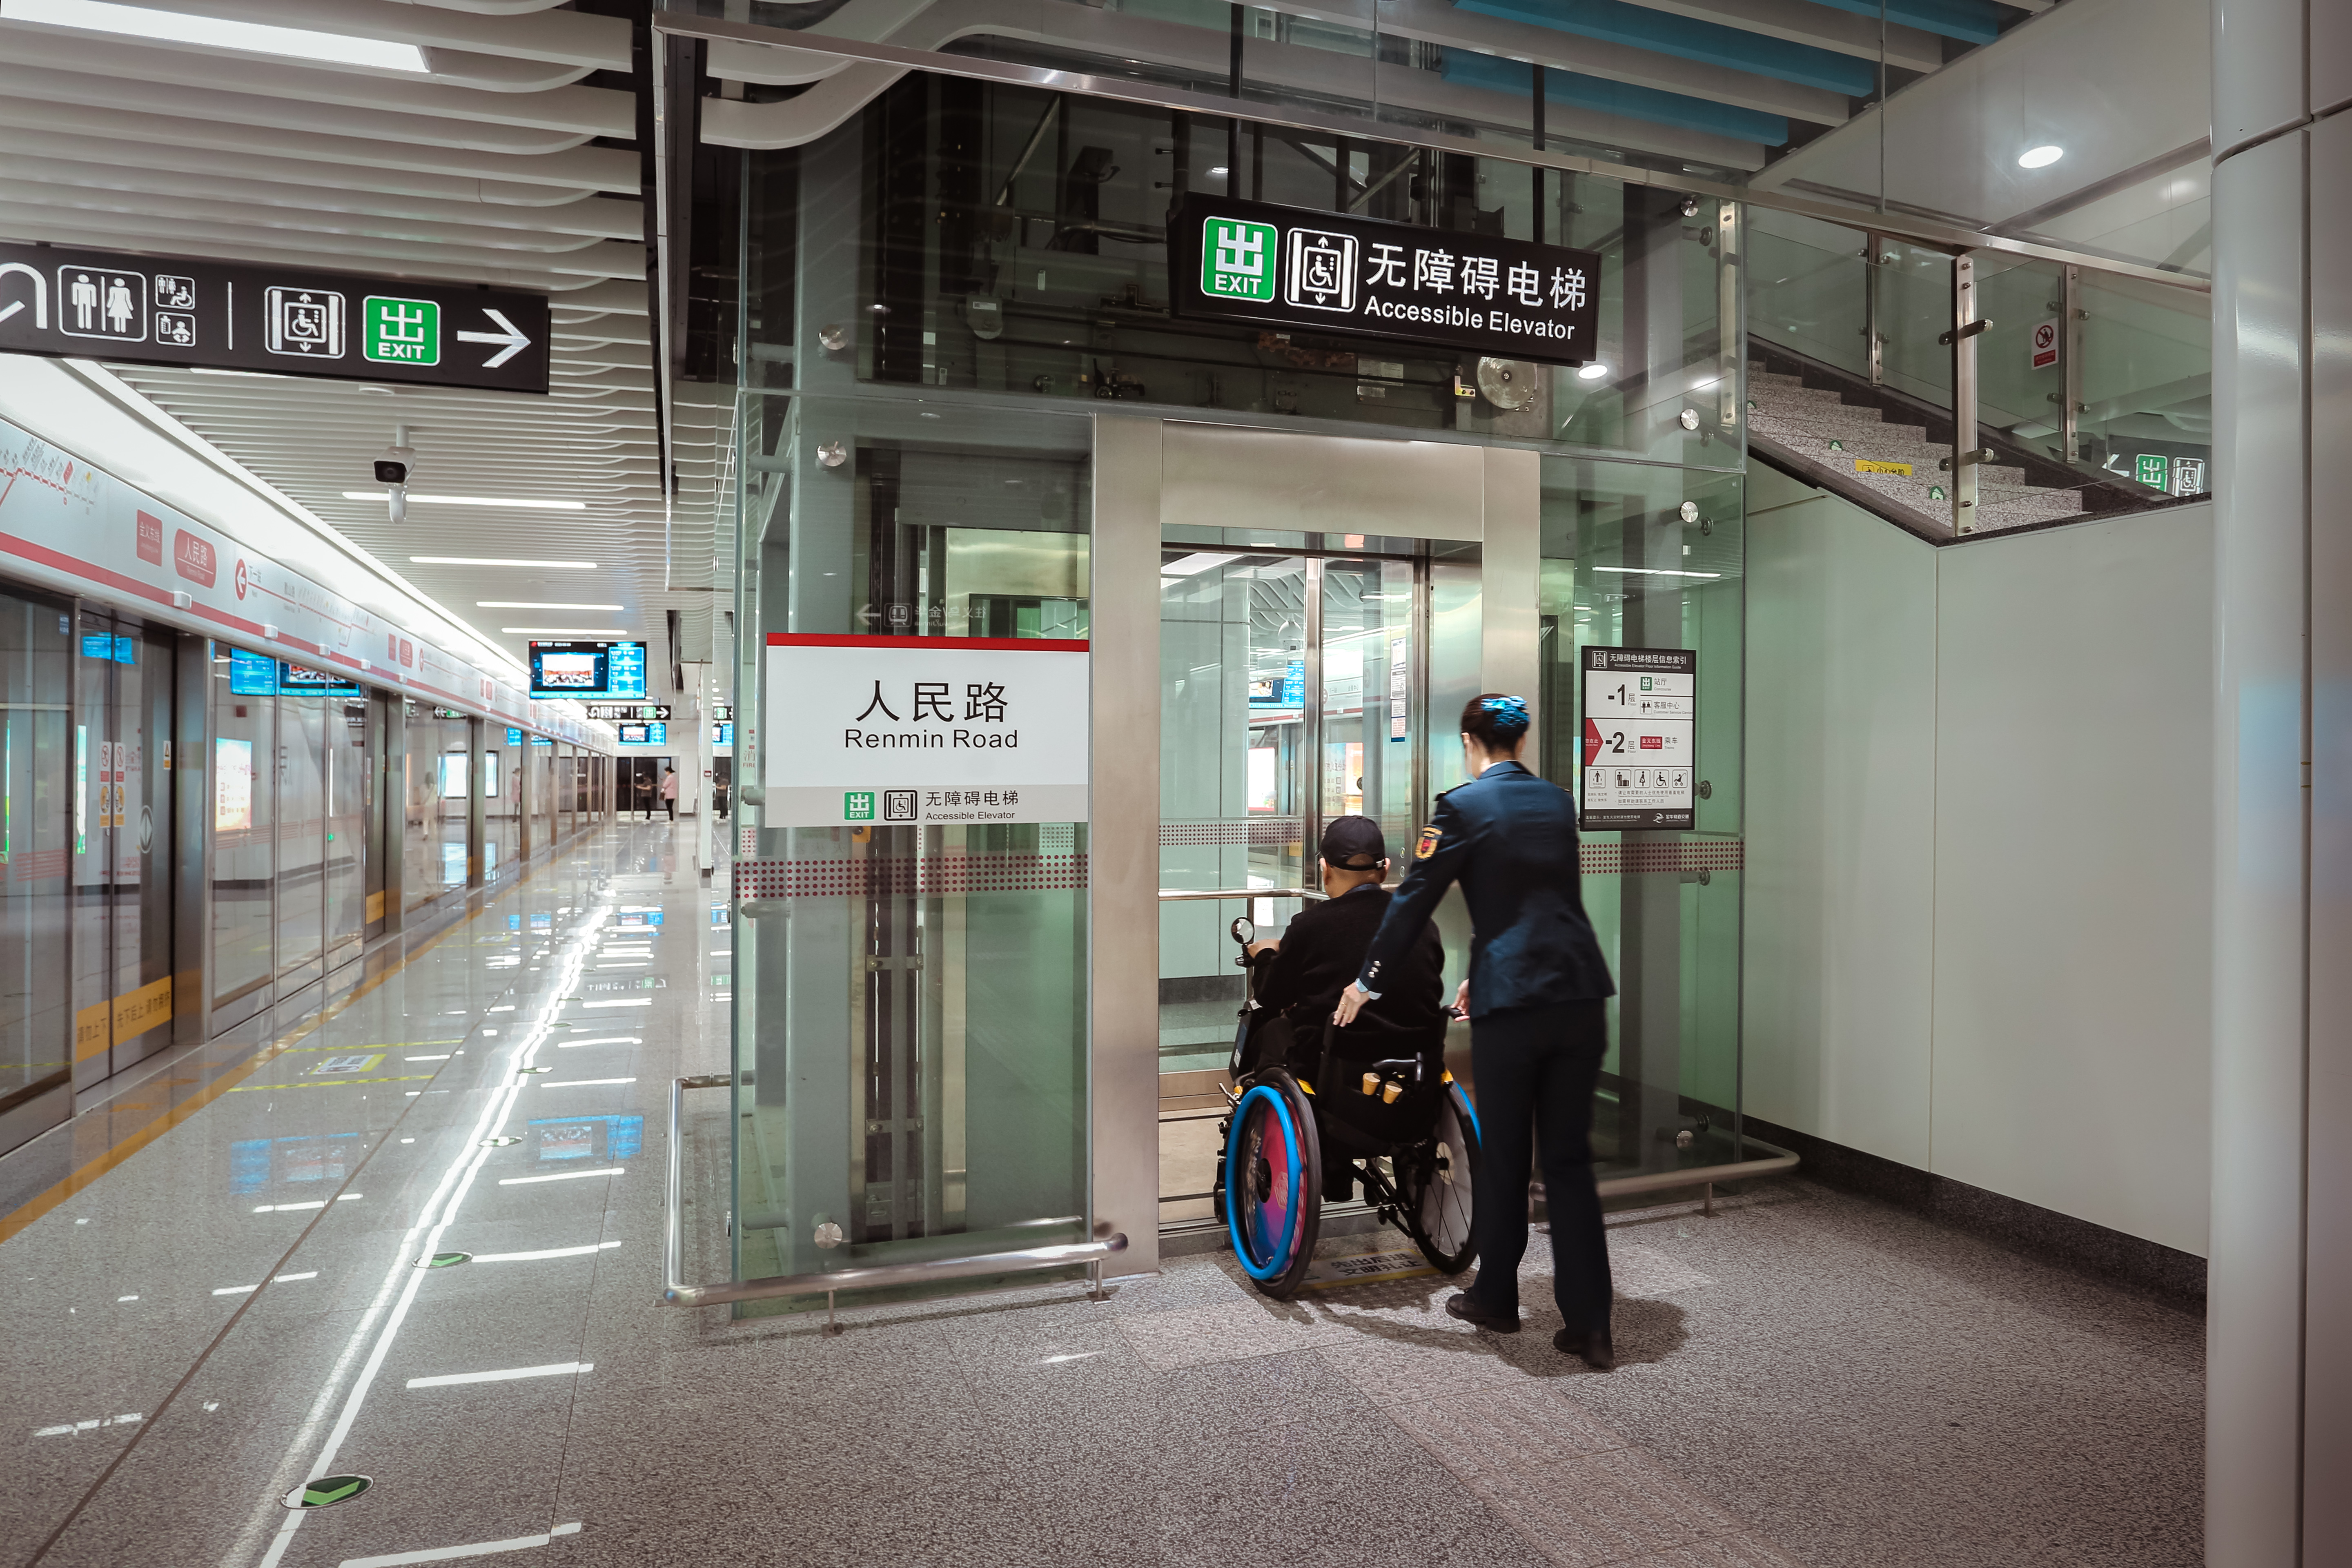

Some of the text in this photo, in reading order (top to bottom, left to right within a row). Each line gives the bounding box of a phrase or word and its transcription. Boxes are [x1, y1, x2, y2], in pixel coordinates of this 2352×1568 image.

[1215, 274, 1262, 295] EXIT
[1366, 243, 1586, 311] 无障碍电梯
[1364, 295, 1575, 341] Accessible Elevator
[378, 342, 425, 359] EXIT
[185, 537, 207, 567] 人民路
[1610, 654, 1686, 664] 无障碍电梯楼层信息索引
[856, 680, 1009, 723] 人民路
[1608, 684, 1625, 706] -1
[1628, 693, 1635, 702] 层
[845, 729, 1018, 748] Renmin Road
[1606, 732, 1625, 753] -2
[1628, 741, 1635, 750] 层
[926, 791, 1018, 807] 无障碍电梯
[926, 811, 1016, 820] Accessible Elevator
[1331, 1253, 1412, 1269] 先出后进
[1339, 1260, 1423, 1276] 文明礼让
